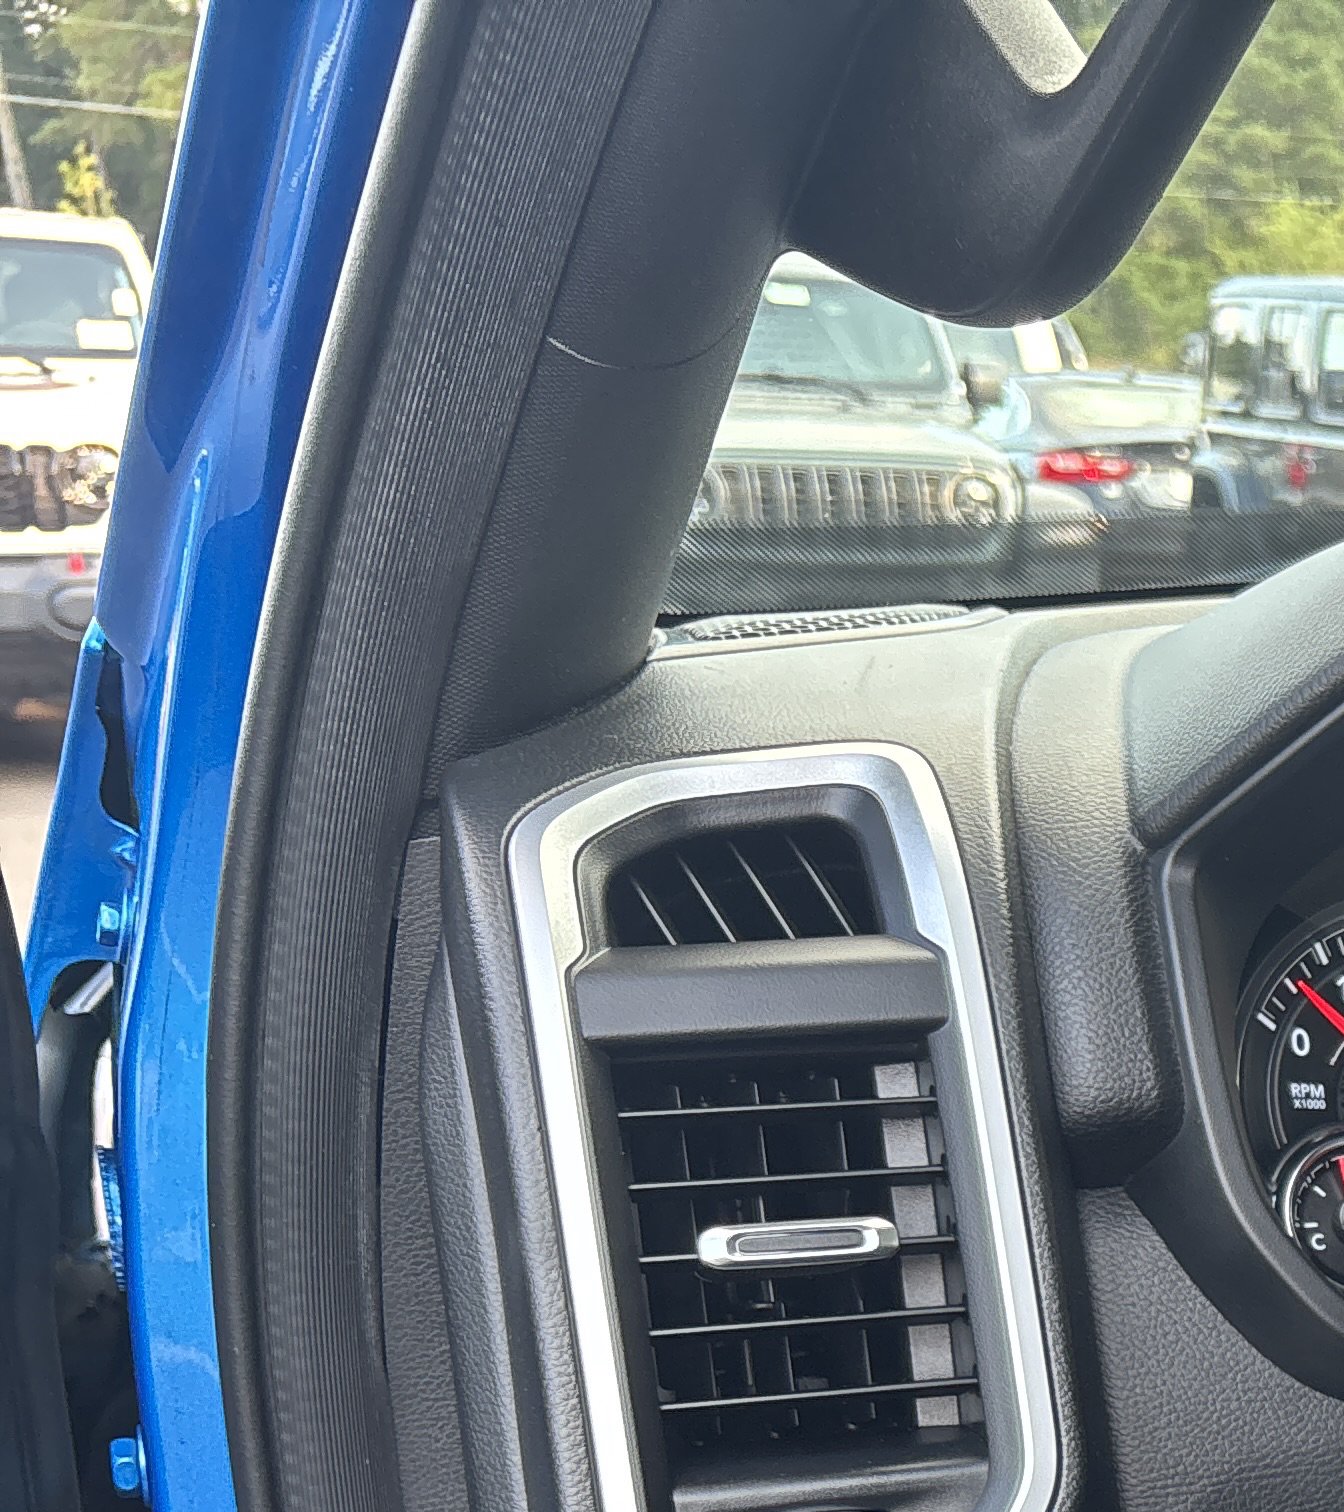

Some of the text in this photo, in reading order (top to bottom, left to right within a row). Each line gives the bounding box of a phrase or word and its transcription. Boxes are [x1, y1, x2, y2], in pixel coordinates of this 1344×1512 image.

[1290, 1027, 1311, 1057] 0
[1289, 1081, 1326, 1100] RPM
[1293, 1097, 1327, 1111] X1000
[1310, 1232, 1327, 1252] C
